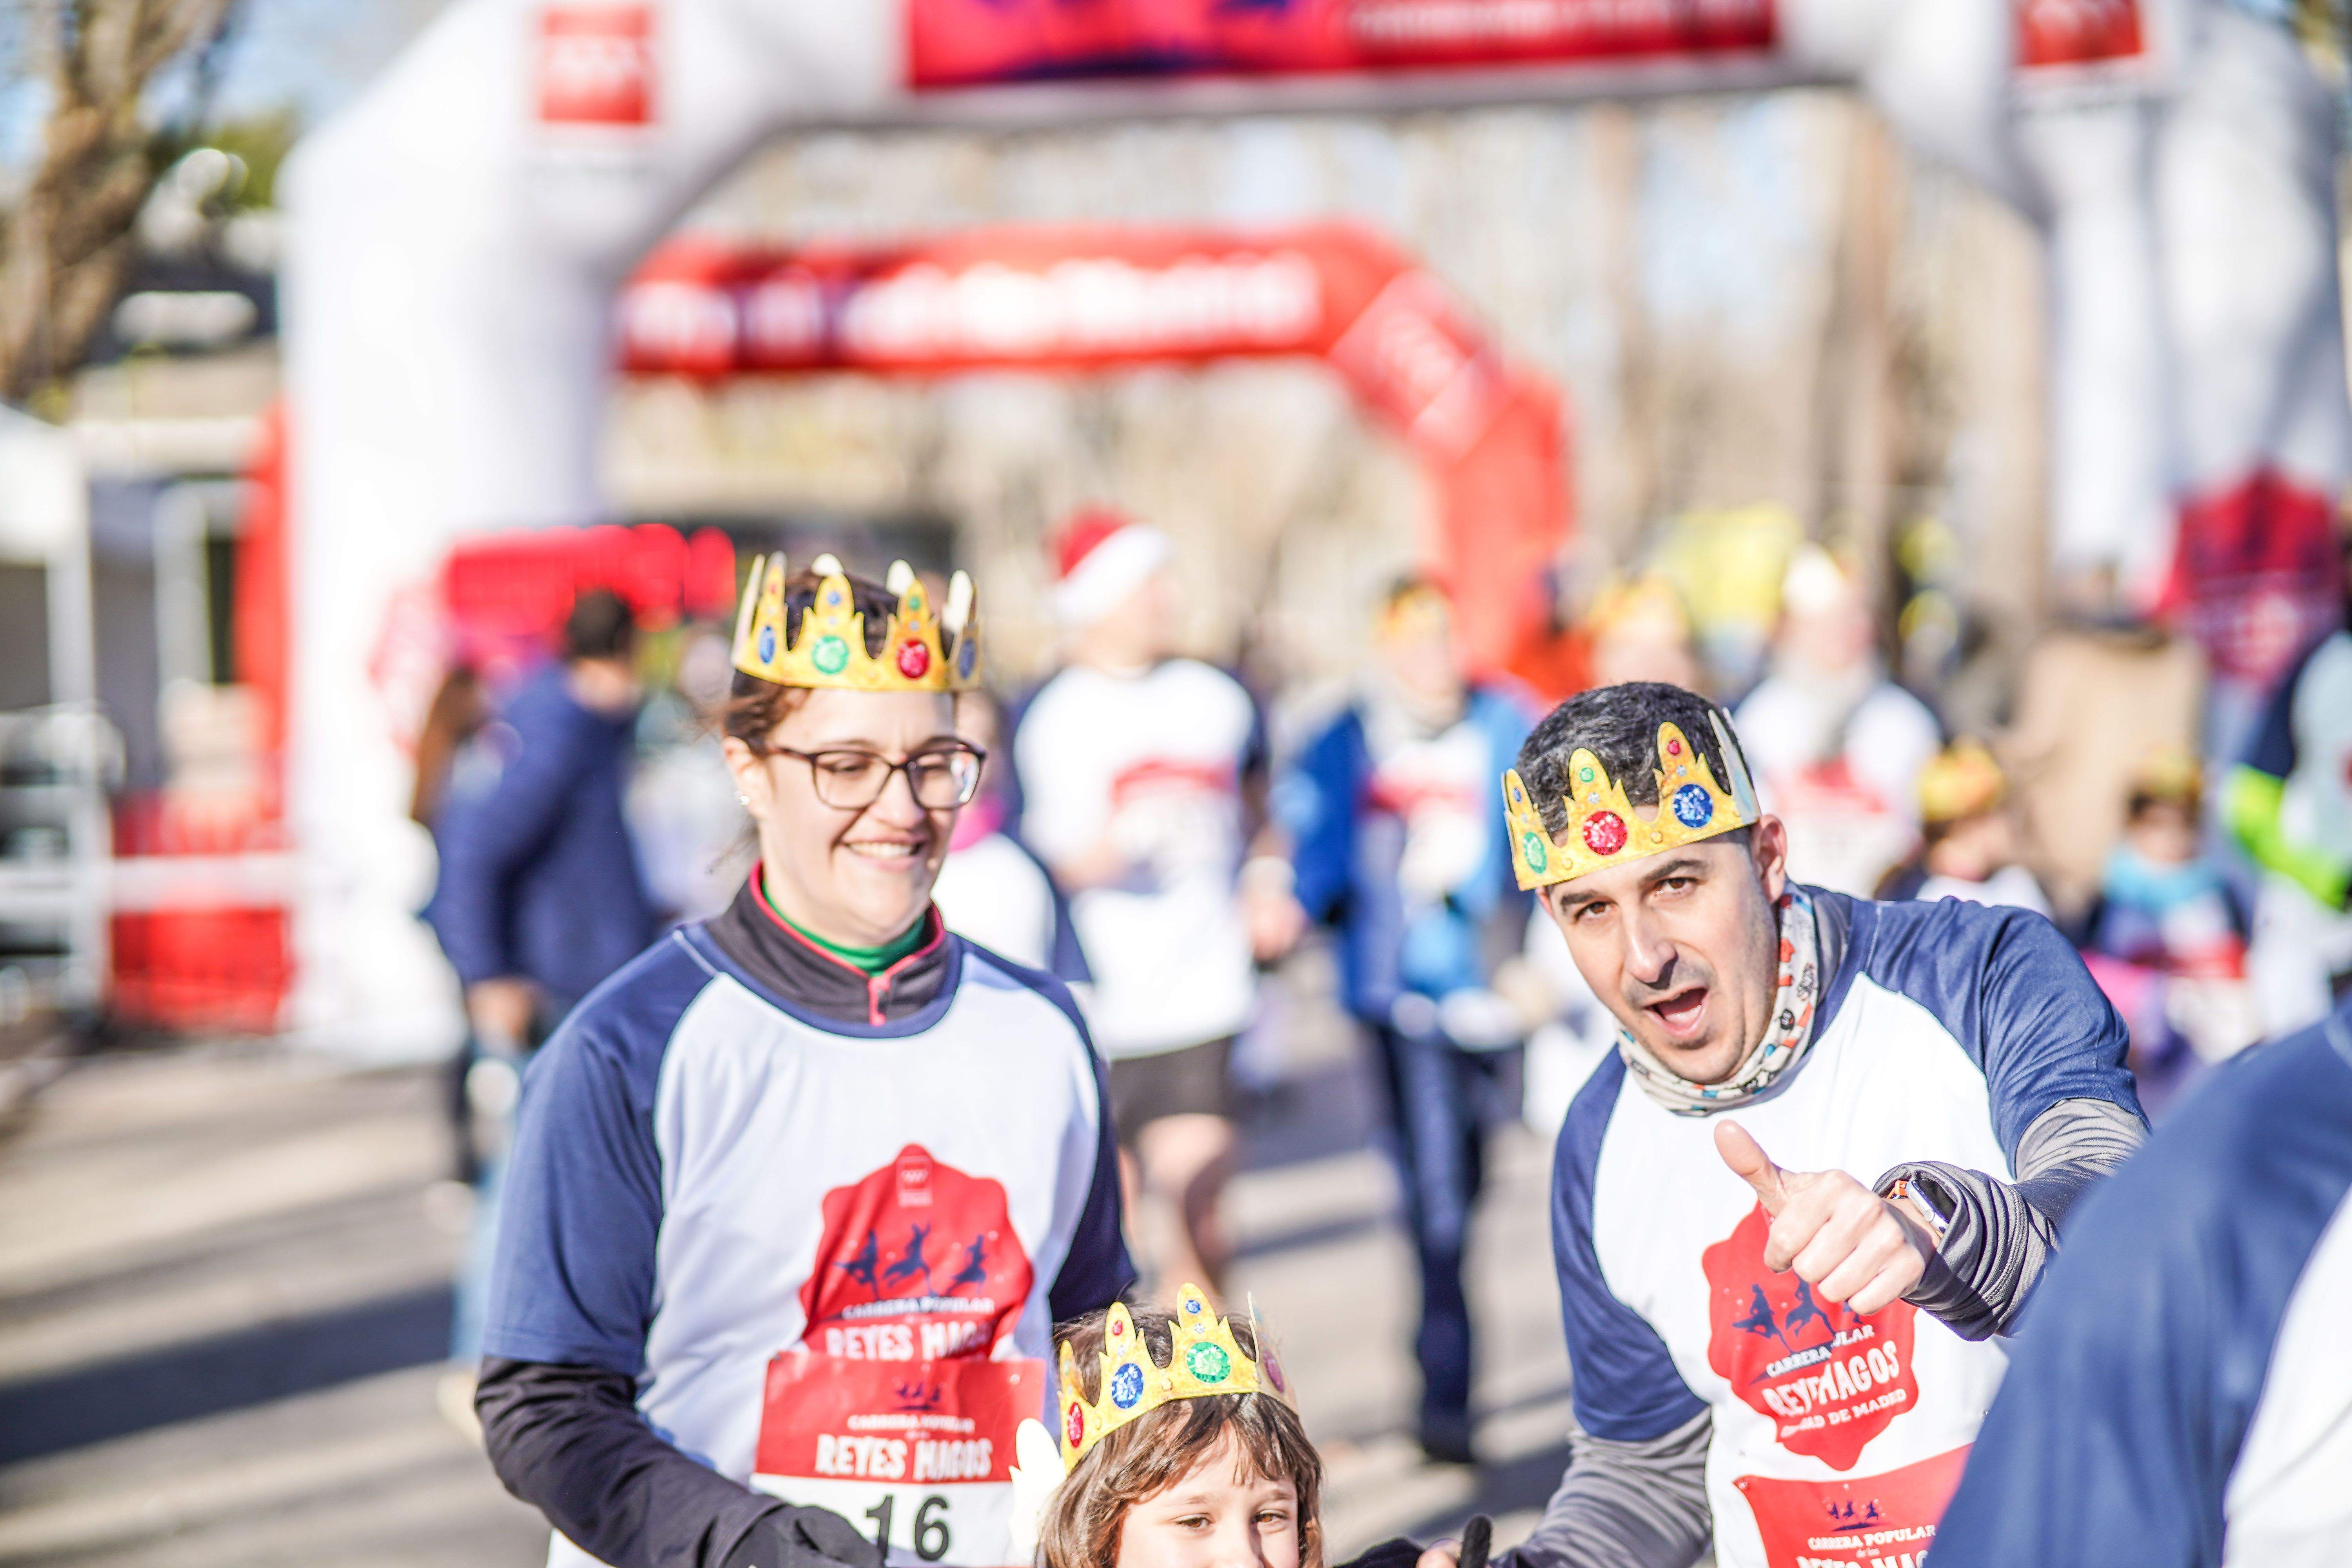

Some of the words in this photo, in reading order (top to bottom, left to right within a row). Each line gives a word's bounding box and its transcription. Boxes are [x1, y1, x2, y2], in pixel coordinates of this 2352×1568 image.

[825, 1325, 914, 1361] REYES
[1827, 1408, 1852, 1425] DE
[815, 1434, 907, 1479] REYES
[866, 1495, 949, 1567] 16
[1808, 1535, 1863, 1551] CARRERA
[1862, 1524, 1937, 1547] POPULAR
